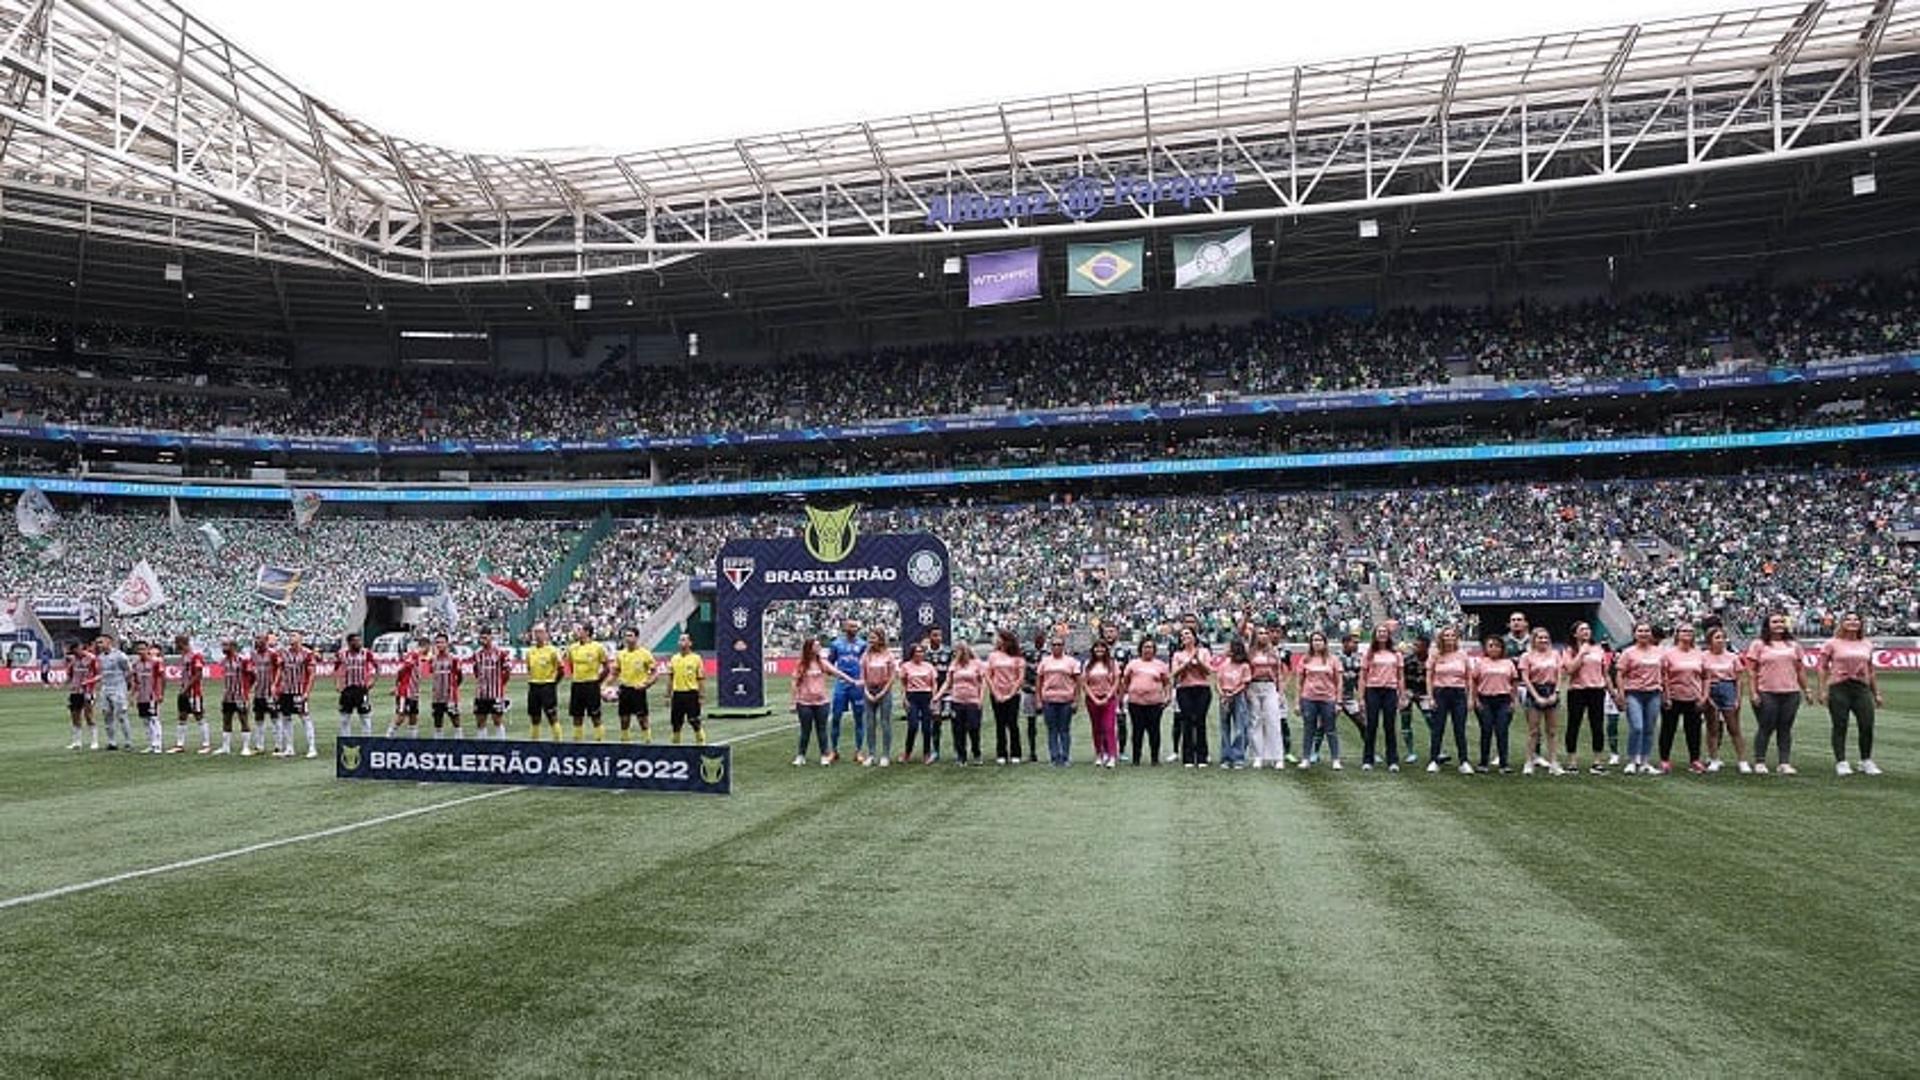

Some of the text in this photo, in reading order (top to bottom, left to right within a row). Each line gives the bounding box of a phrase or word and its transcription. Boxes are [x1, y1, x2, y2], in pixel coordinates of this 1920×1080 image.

[926, 174, 1237, 225] Allianz Parque
[1794, 427, 1866, 442] POPULOS
[764, 566, 898, 584] BRASILEIRÃO
[370, 751, 689, 779] BRASILEIRÃO ASSAÍ 2022
